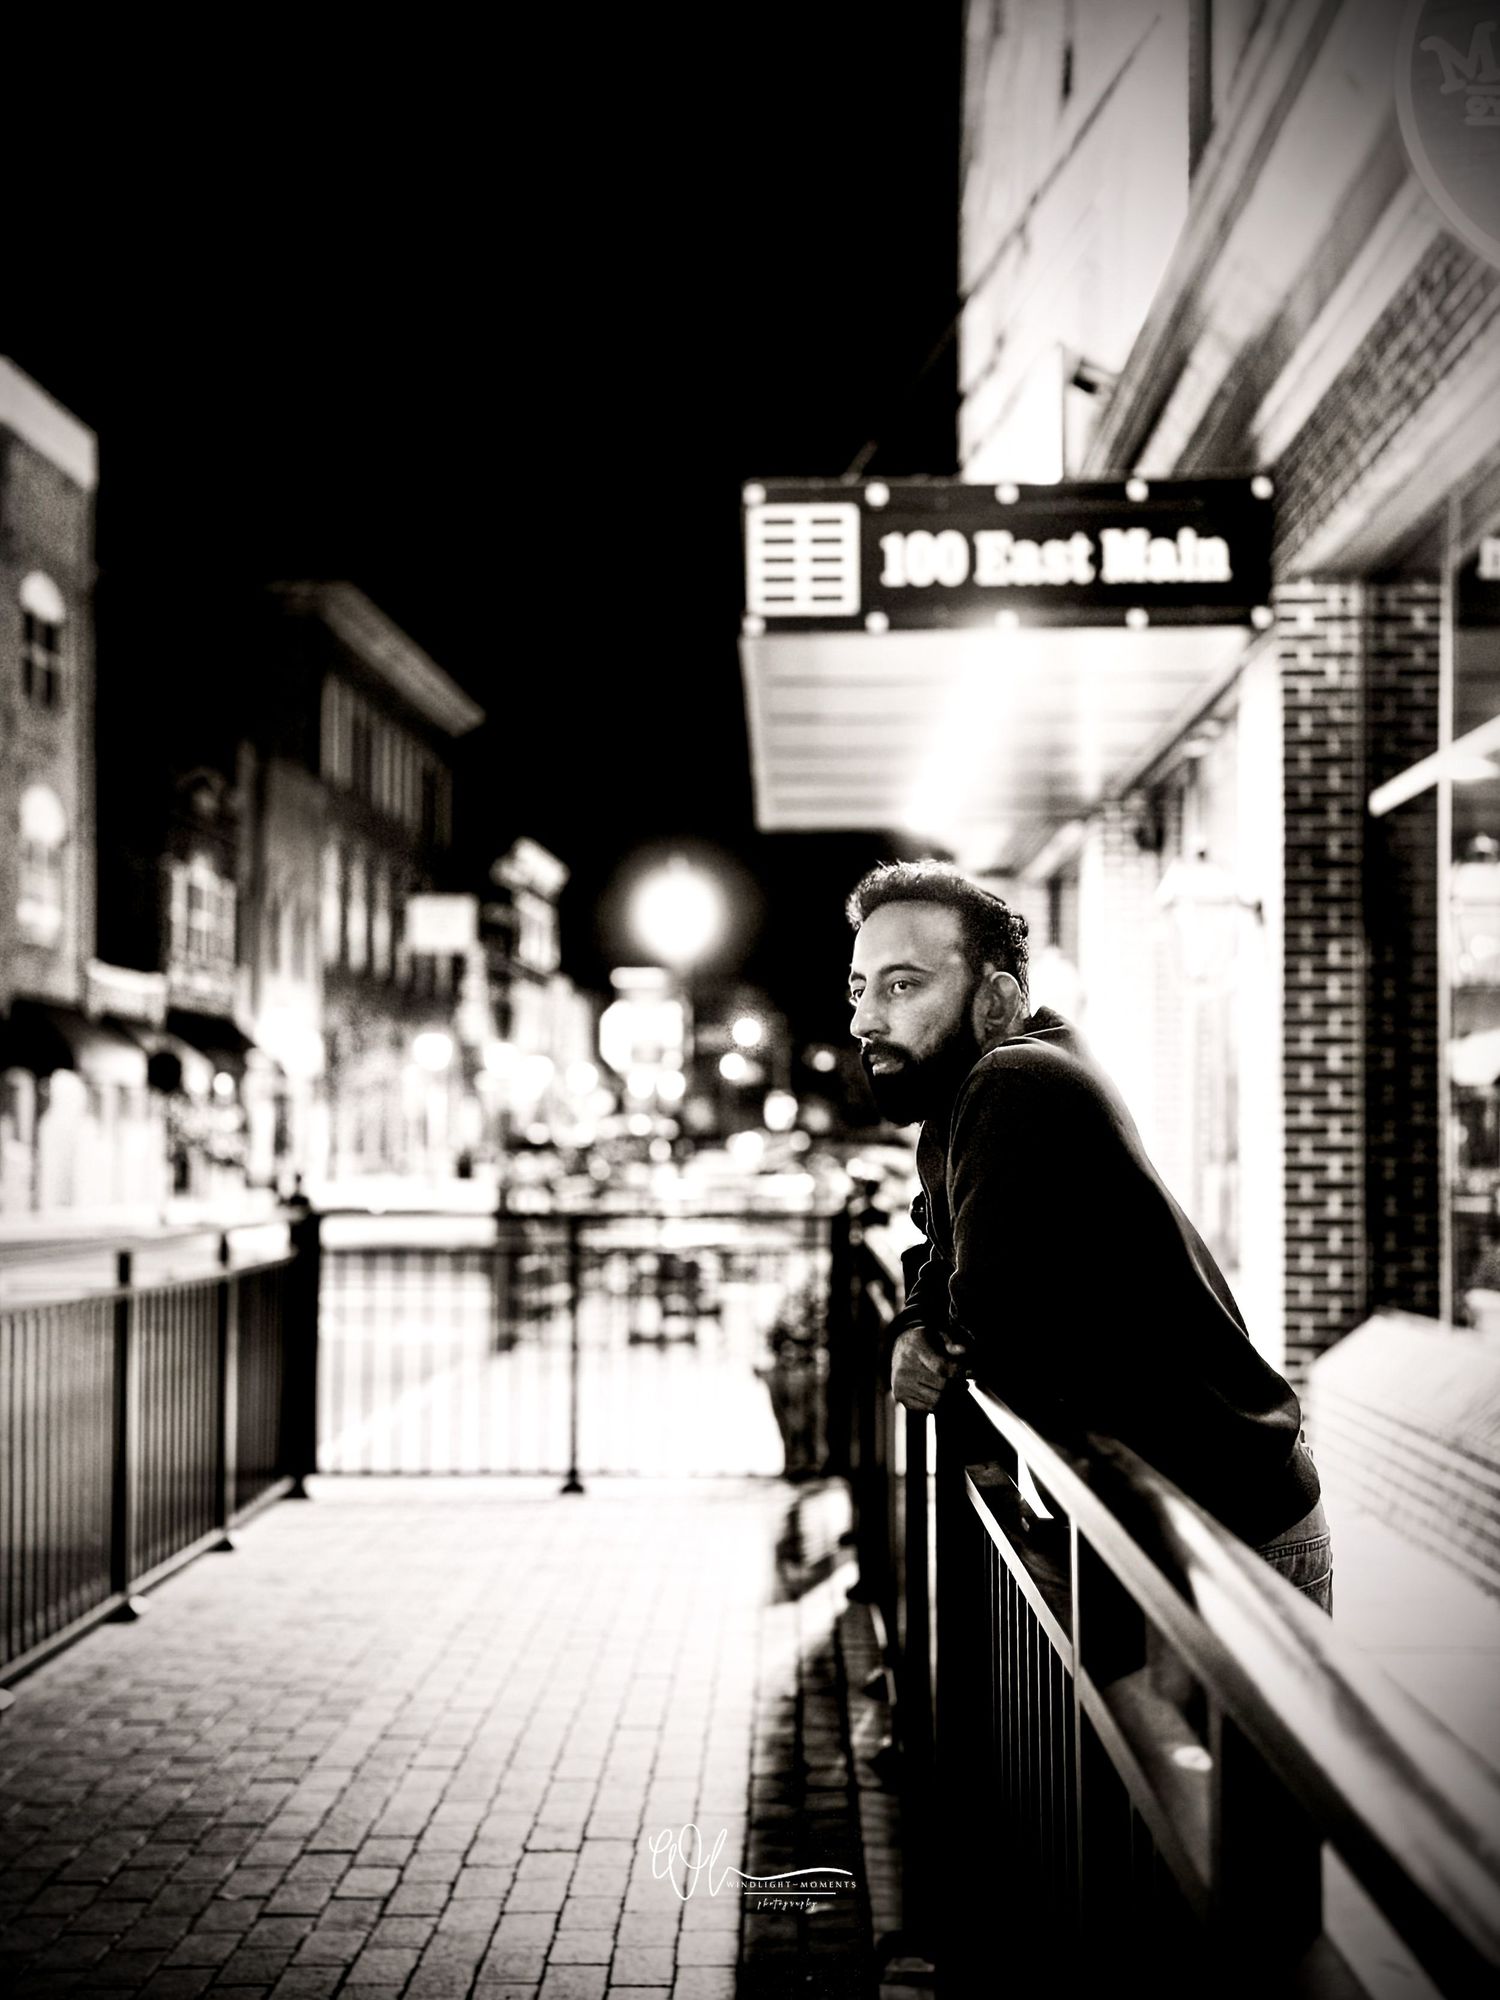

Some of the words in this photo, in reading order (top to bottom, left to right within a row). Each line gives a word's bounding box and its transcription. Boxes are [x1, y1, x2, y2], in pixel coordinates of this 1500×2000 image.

[880, 530, 970, 587] 100
[973, 529, 1096, 587] East
[1099, 526, 1232, 584] Main
